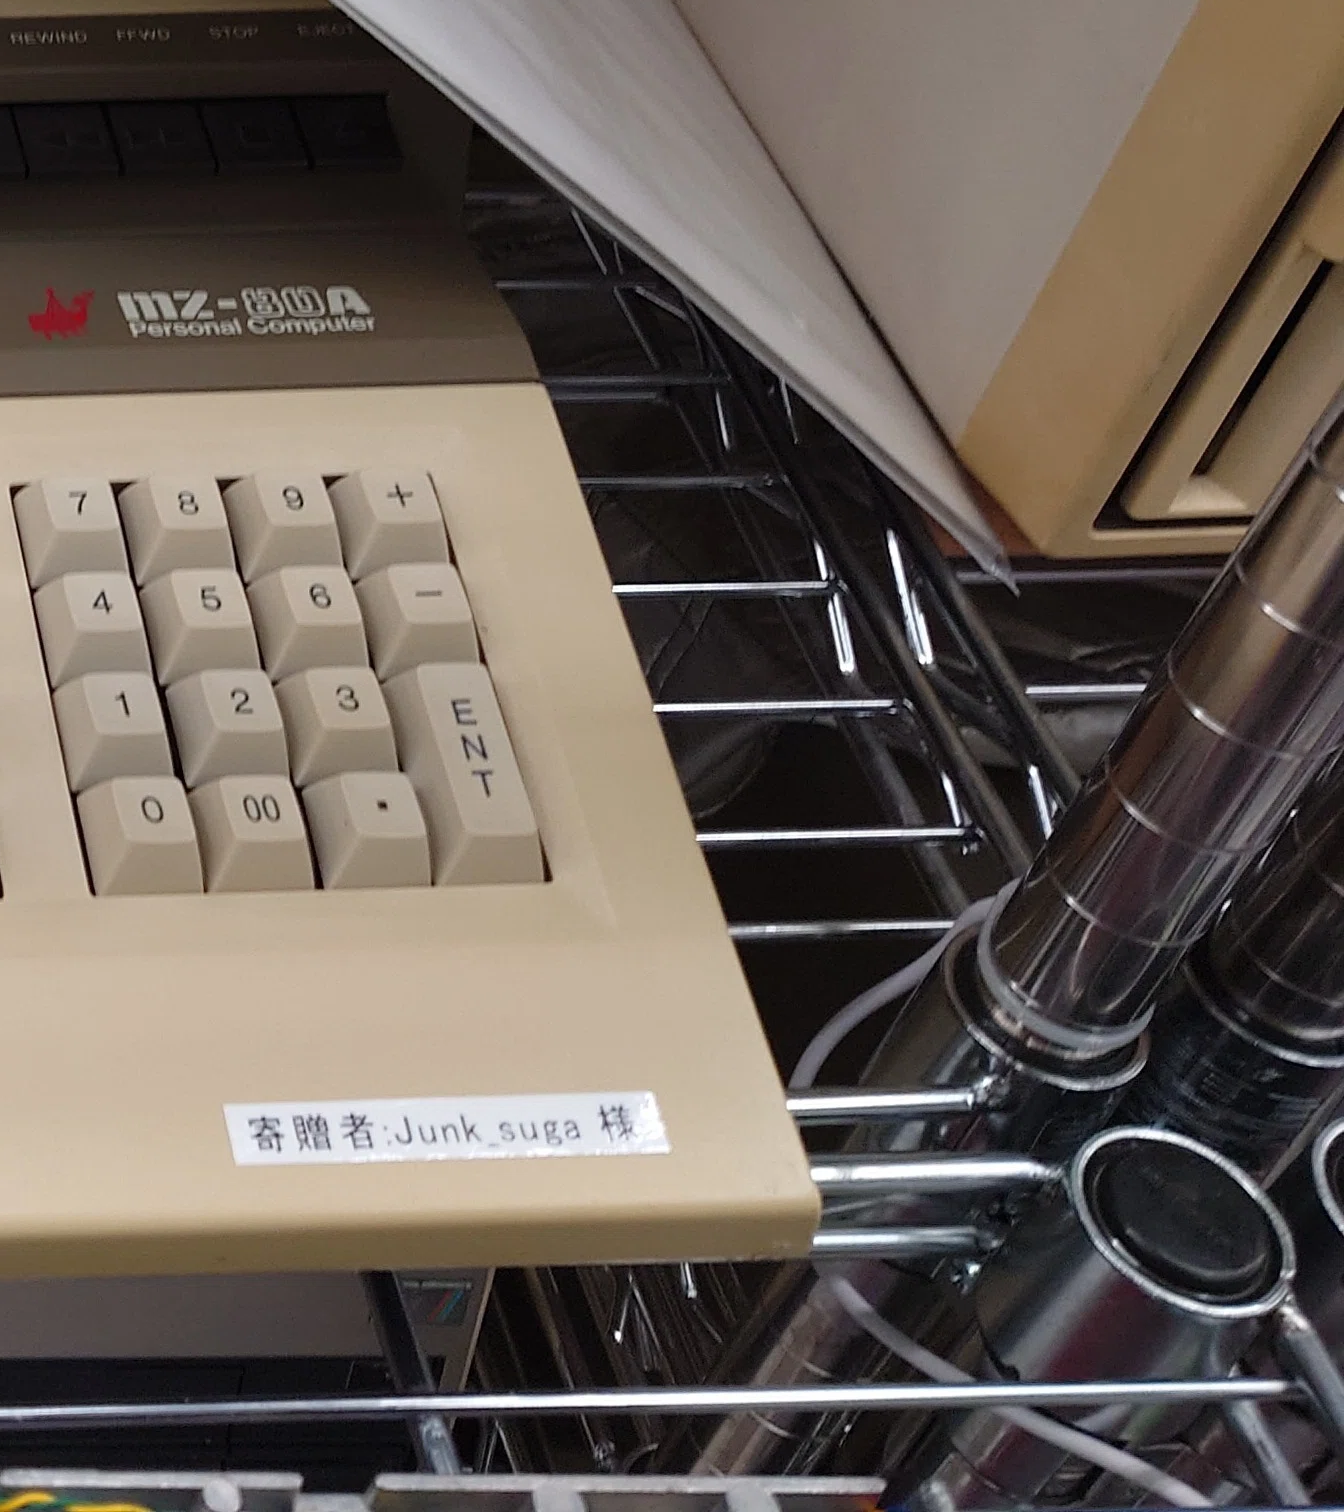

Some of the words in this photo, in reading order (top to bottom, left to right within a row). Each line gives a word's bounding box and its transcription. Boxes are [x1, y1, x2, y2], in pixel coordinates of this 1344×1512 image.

[10, 29, 88, 46] REWIND
[208, 24, 259, 40] STOP
[128, 316, 242, 339] Personal
[246, 313, 377, 337] Computer
[68, 493, 87, 515] 7
[178, 493, 199, 514] 8
[283, 488, 304, 510] 9
[388, 484, 412, 507] +
[93, 591, 112, 614] 4
[201, 587, 221, 611] 5
[309, 584, 331, 608] 6
[116, 692, 129, 717] 1
[231, 689, 253, 714] 2
[336, 687, 359, 711] 3
[451, 699, 493, 798] ENT
[141, 797, 164, 823] 0
[243, 795, 280, 822] 00
[248, 1109, 582, 1154] 寄贈者:Junk_suga
[598, 1103, 636, 1140] 様
